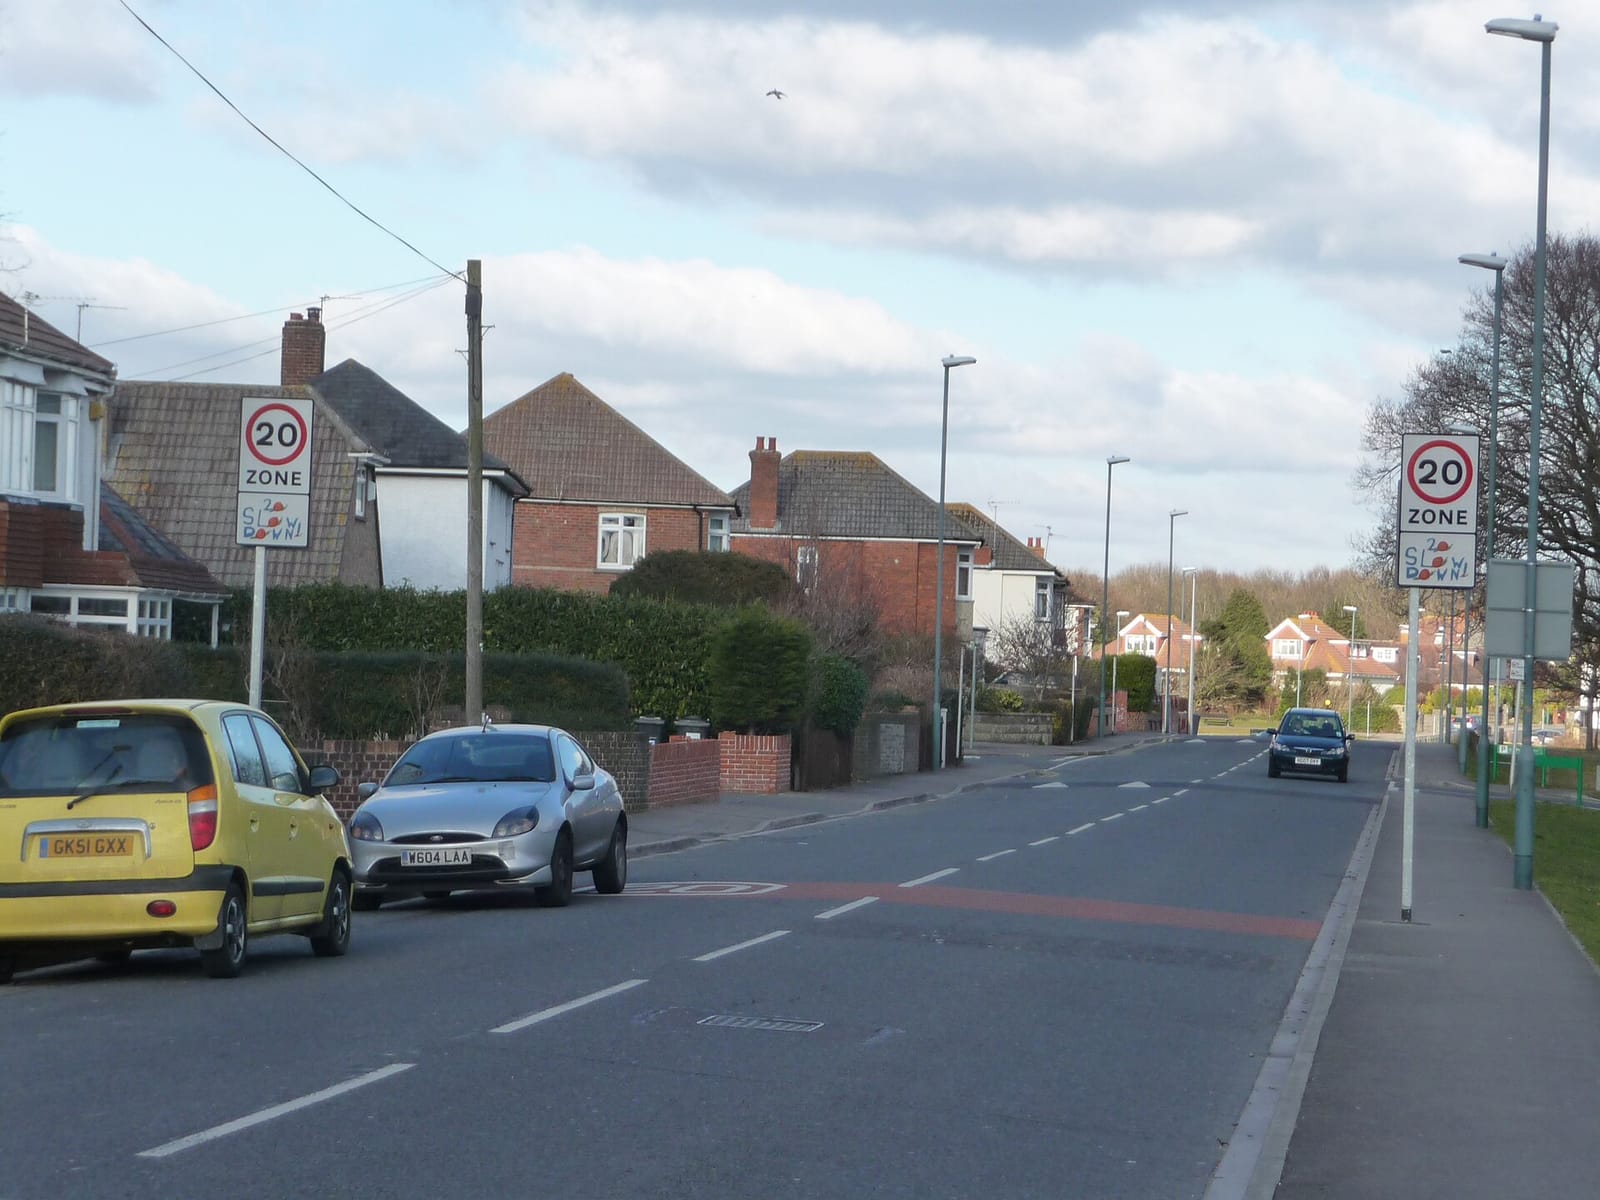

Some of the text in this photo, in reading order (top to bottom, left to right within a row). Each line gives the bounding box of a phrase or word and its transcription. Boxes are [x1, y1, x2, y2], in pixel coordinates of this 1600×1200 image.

[256, 422, 298, 447] 20
[246, 470, 302, 486] ZONE
[1418, 459, 1463, 486] 20
[1408, 508, 1468, 525] ZONE
[54, 838, 127, 855] GK51 GXX
[408, 850, 469, 864] W604 LAA
